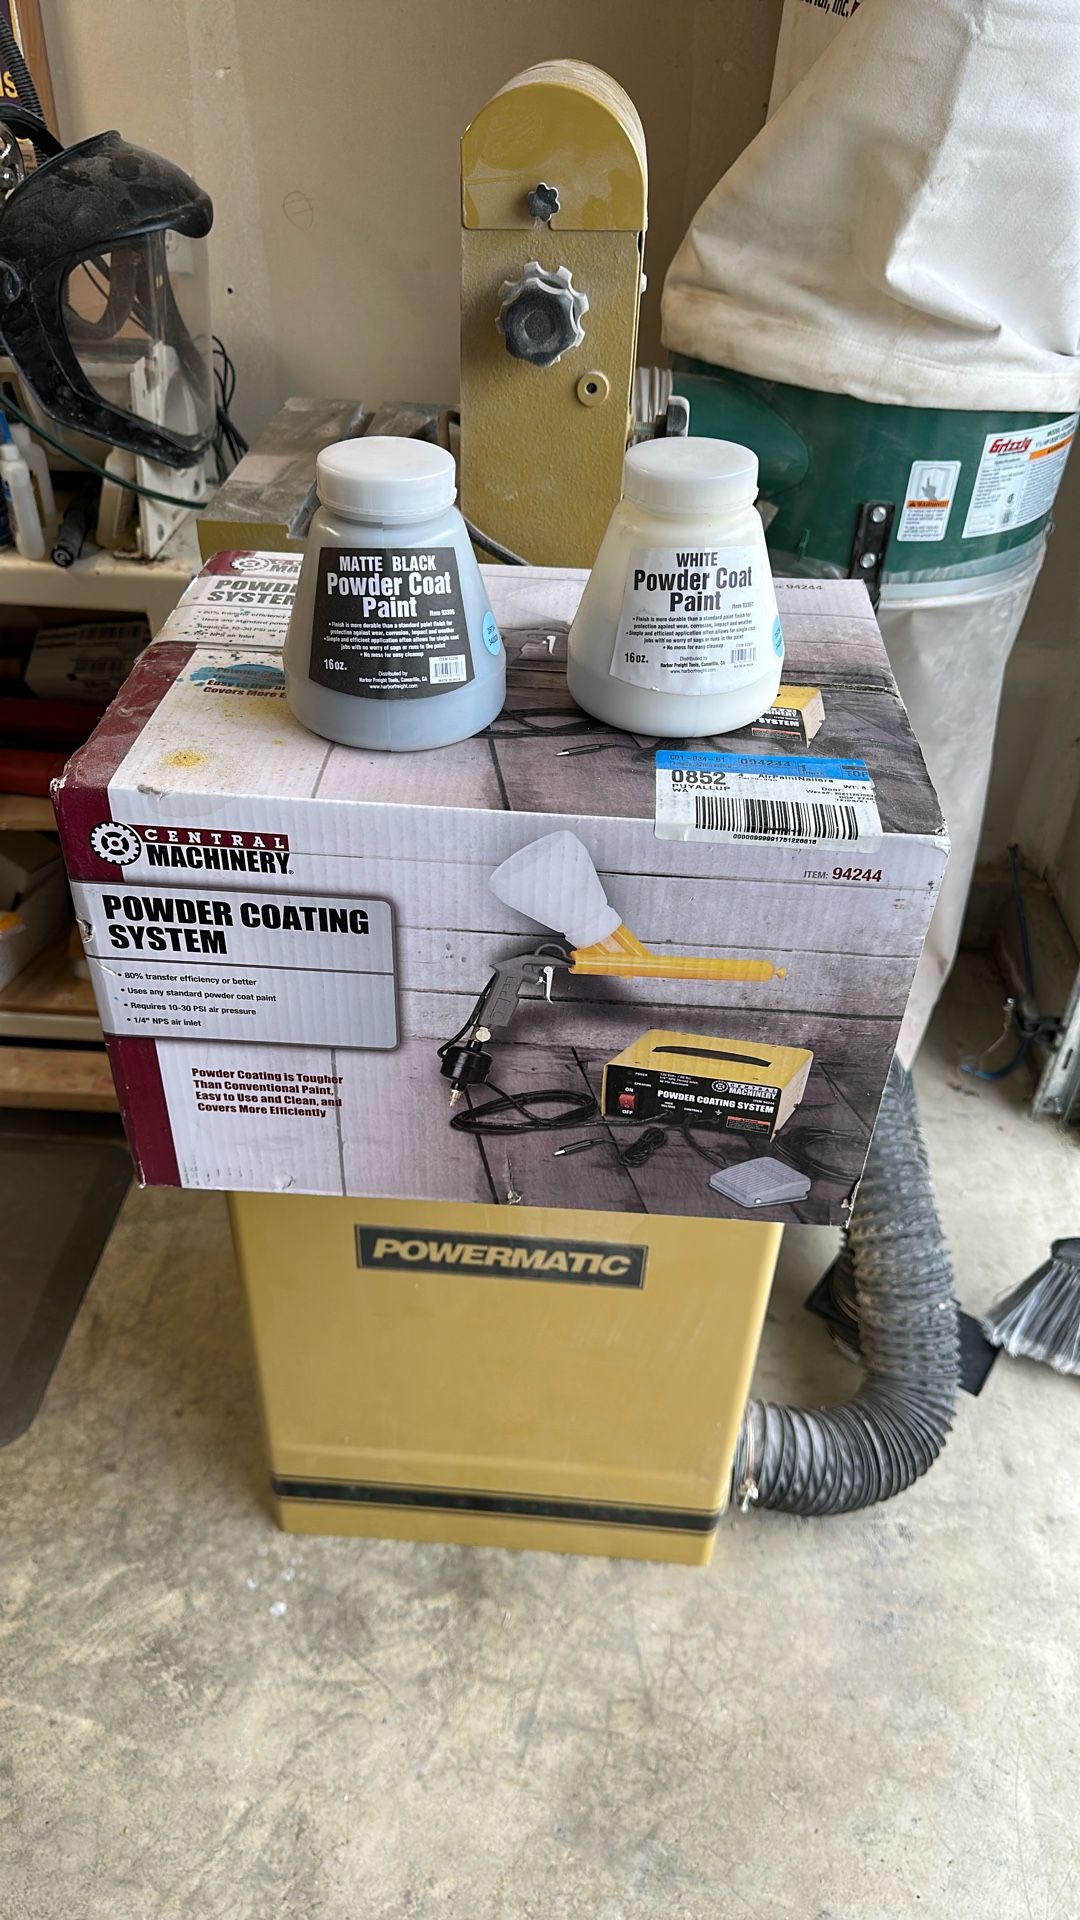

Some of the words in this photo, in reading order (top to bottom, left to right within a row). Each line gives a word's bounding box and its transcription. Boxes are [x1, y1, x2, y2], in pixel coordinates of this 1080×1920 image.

[989, 436, 1032, 453] Grizzly
[339, 555, 383, 571] MATTE
[392, 555, 436, 571] BLACK
[676, 552, 718, 567] WHITE
[327, 572, 402, 596] Powder
[409, 572, 452, 596] Coat
[634, 569, 710, 591] Powder
[716, 566, 752, 589] Coat
[363, 597, 417, 618] Paint
[670, 591, 721, 612] Paint
[203, 687, 245, 696] Covers
[246, 690, 277, 698] More
[759, 718, 800, 727] SYSTEM
[671, 769, 726, 785] 0852
[672, 783, 731, 791] PUYALLUP
[144, 829, 285, 850] CENTRAL
[146, 845, 290, 874] MACHINERY
[804, 870, 828, 879] ITEM:
[832, 867, 882, 882] 94244
[102, 894, 233, 926] POWDER
[240, 902, 369, 935] COATING
[108, 924, 227, 954] SYSTEM
[124, 972, 143, 980] 80%
[145, 973, 177, 981] transfer
[180, 974, 219, 985] efficiency
[232, 978, 257, 986] better
[127, 987, 147, 995] Uses
[166, 989, 202, 998] standard
[204, 991, 235, 1000] powder
[256, 994, 277, 1002] paint
[130, 1002, 166, 1011] Requires
[168, 1004, 192, 1012] 10-30
[221, 1008, 257, 1016] pressure
[183, 1019, 202, 1027] inlet
[192, 1068, 235, 1079] Powder
[237, 1070, 282, 1082] Coating
[284, 1073, 294, 1082] is
[296, 1073, 343, 1085] Tougher
[193, 1080, 222, 1090] Than
[224, 1081, 300, 1093] Conventional
[302, 1086, 334, 1096] Paint,
[729, 1087, 777, 1100] MACHINERY
[196, 1091, 221, 1102] Easy
[223, 1093, 234, 1101] to
[237, 1093, 257, 1103] Use
[261, 1095, 282, 1104] and
[284, 1095, 320, 1106] Clean,
[321, 1098, 342, 1107] and
[657, 1090, 695, 1102] POWDER
[696, 1096, 736, 1108] COATING
[737, 1101, 774, 1114] SYSTEM
[198, 1103, 237, 1113] Covers
[239, 1105, 268, 1114] More
[270, 1106, 326, 1118] Efficiently
[373, 1238, 630, 1276] POWERMATIC
